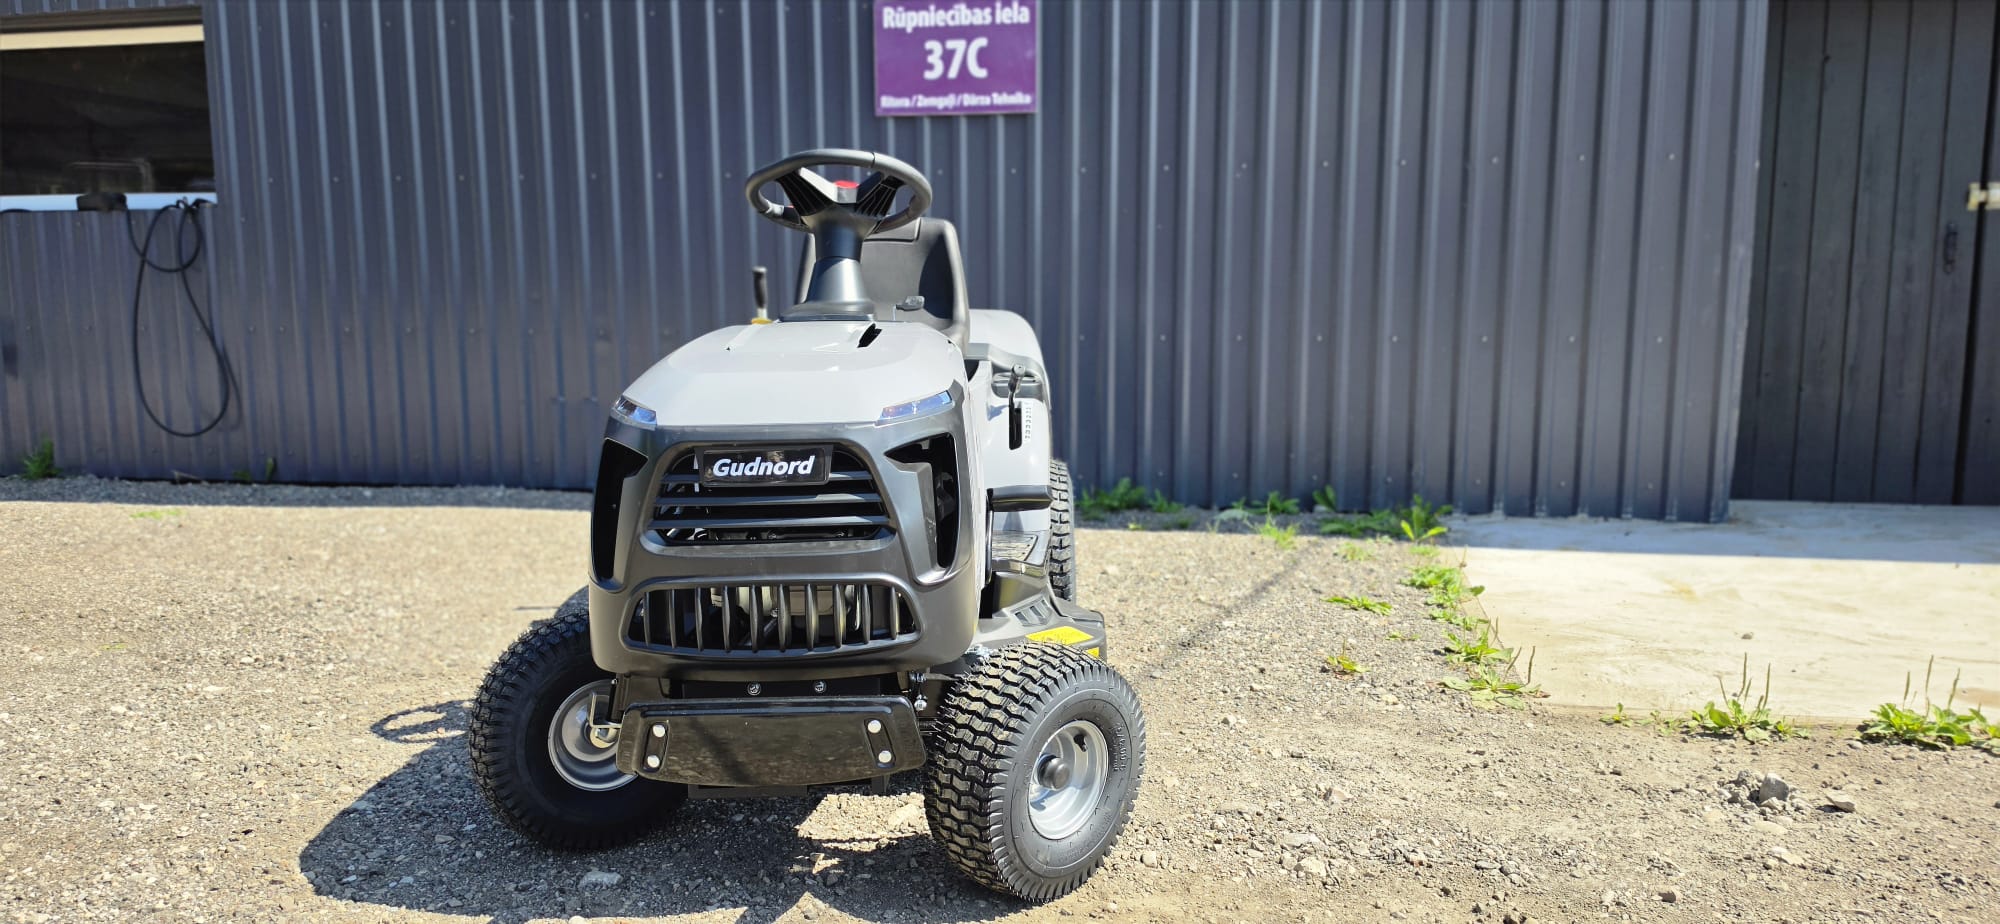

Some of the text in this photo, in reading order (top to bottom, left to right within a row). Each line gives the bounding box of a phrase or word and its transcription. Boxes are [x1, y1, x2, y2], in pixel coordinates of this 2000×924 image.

[882, 4, 992, 33] Rūpniecības
[923, 37, 988, 80] 37C
[712, 455, 816, 477] Gudnord
